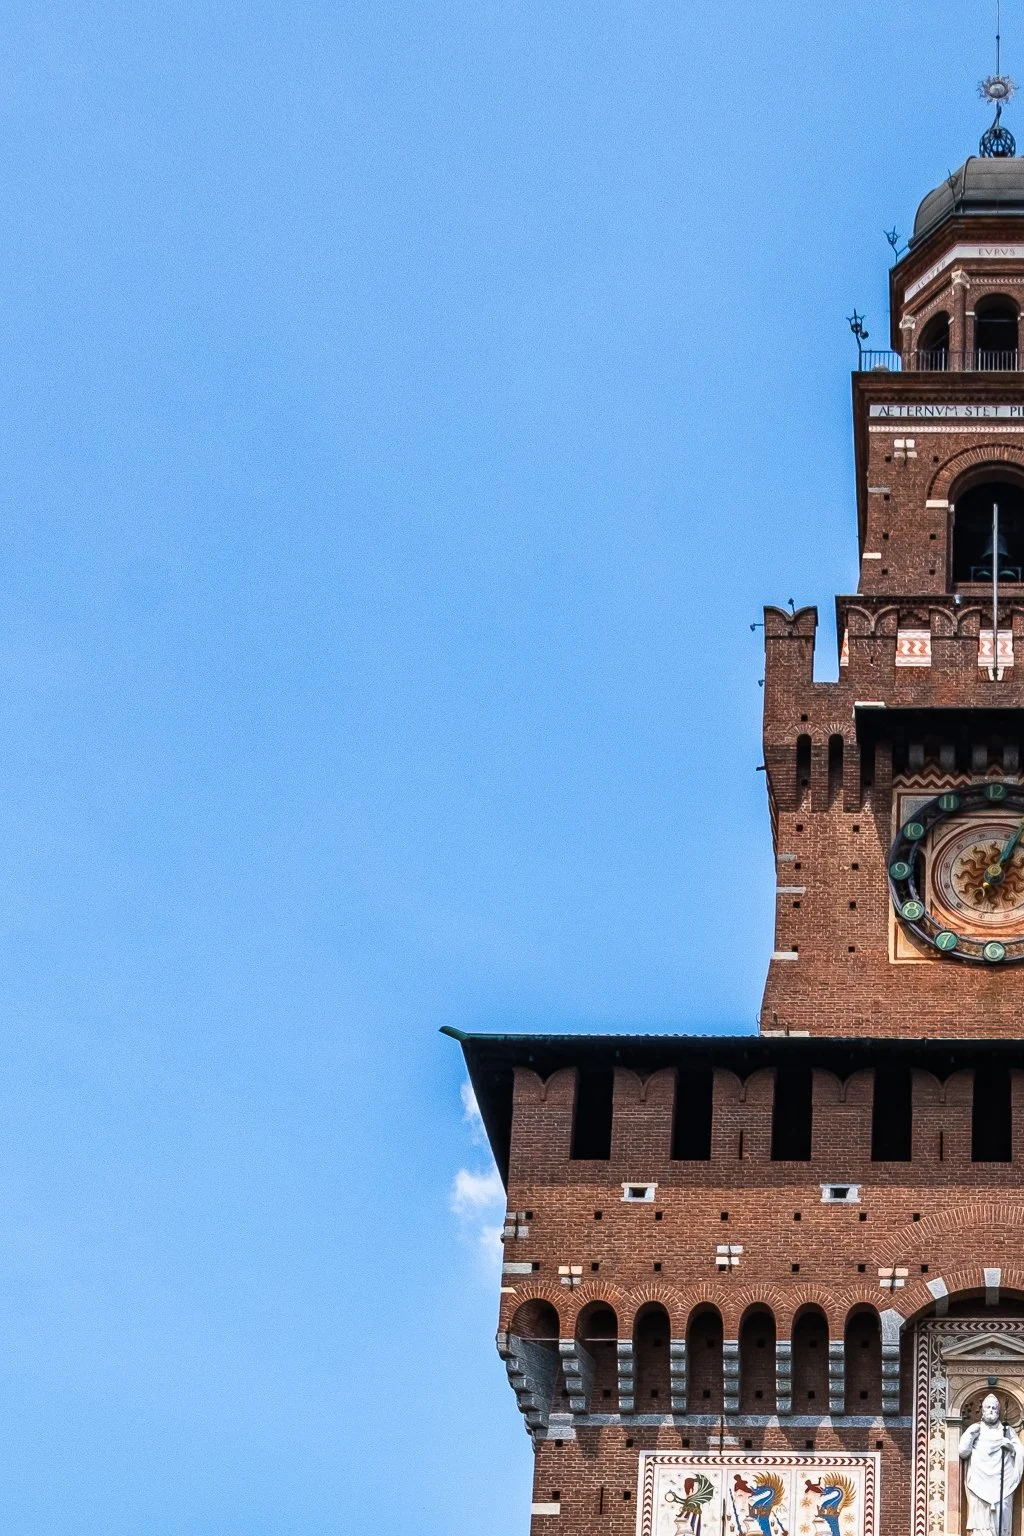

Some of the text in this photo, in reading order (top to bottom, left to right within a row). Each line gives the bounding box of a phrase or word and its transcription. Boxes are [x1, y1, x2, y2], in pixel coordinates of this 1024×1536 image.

[978, 248, 1016, 256] EVRVS
[965, 406, 1001, 417] STET
[989, 784, 1003, 798] 12
[943, 797, 954, 809] 11
[907, 825, 924, 837] 10
[895, 864, 907, 877] 9
[905, 902, 919, 919] 8
[941, 932, 953, 948] 7
[988, 944, 1000, 959] 6
